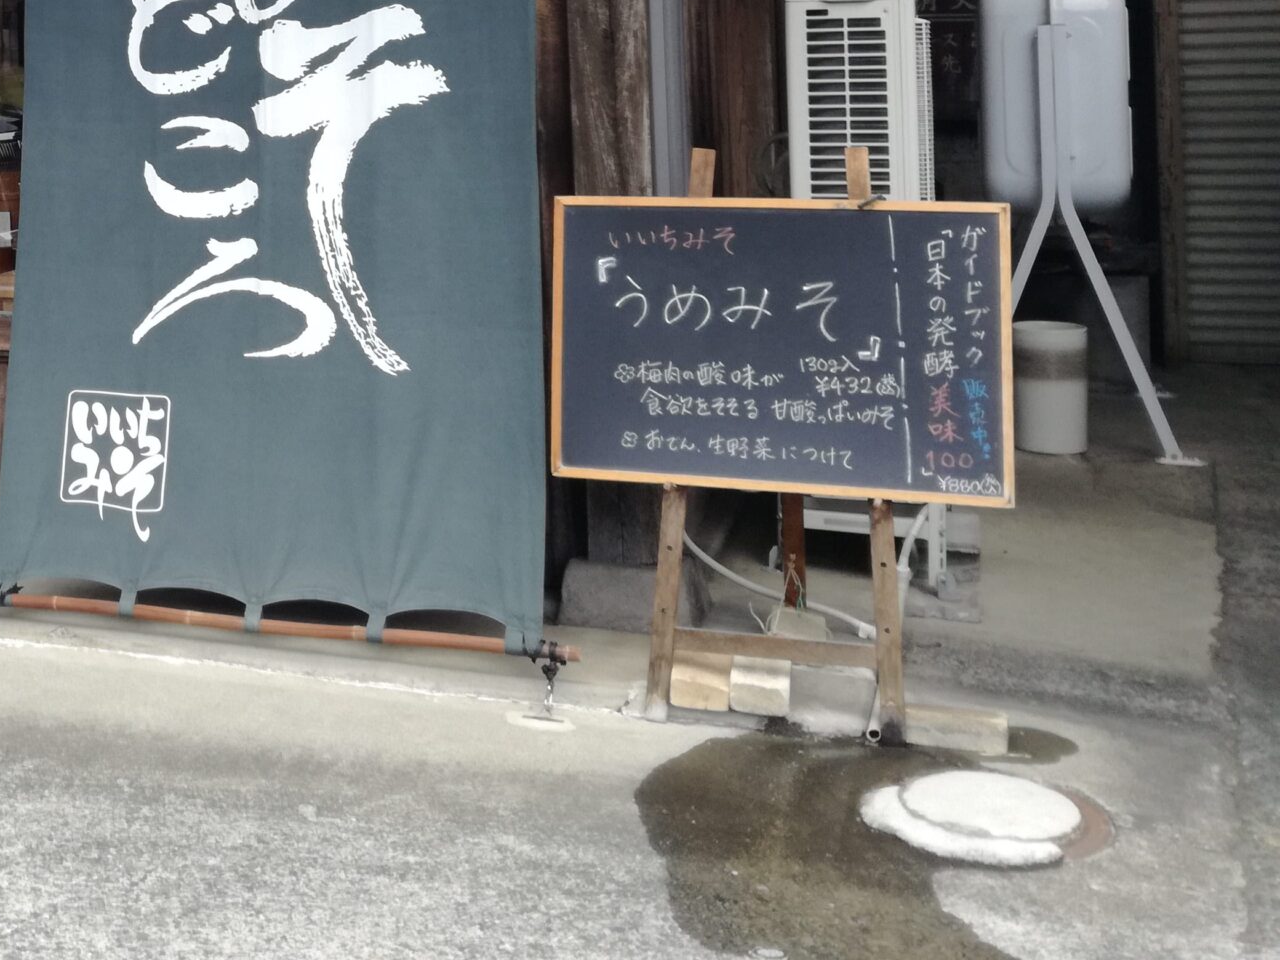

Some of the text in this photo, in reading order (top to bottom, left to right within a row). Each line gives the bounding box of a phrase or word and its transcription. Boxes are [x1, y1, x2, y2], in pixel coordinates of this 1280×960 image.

[608, 225, 736, 256] いいちみそ
[640, 386, 759, 420] 食欲をそそる
